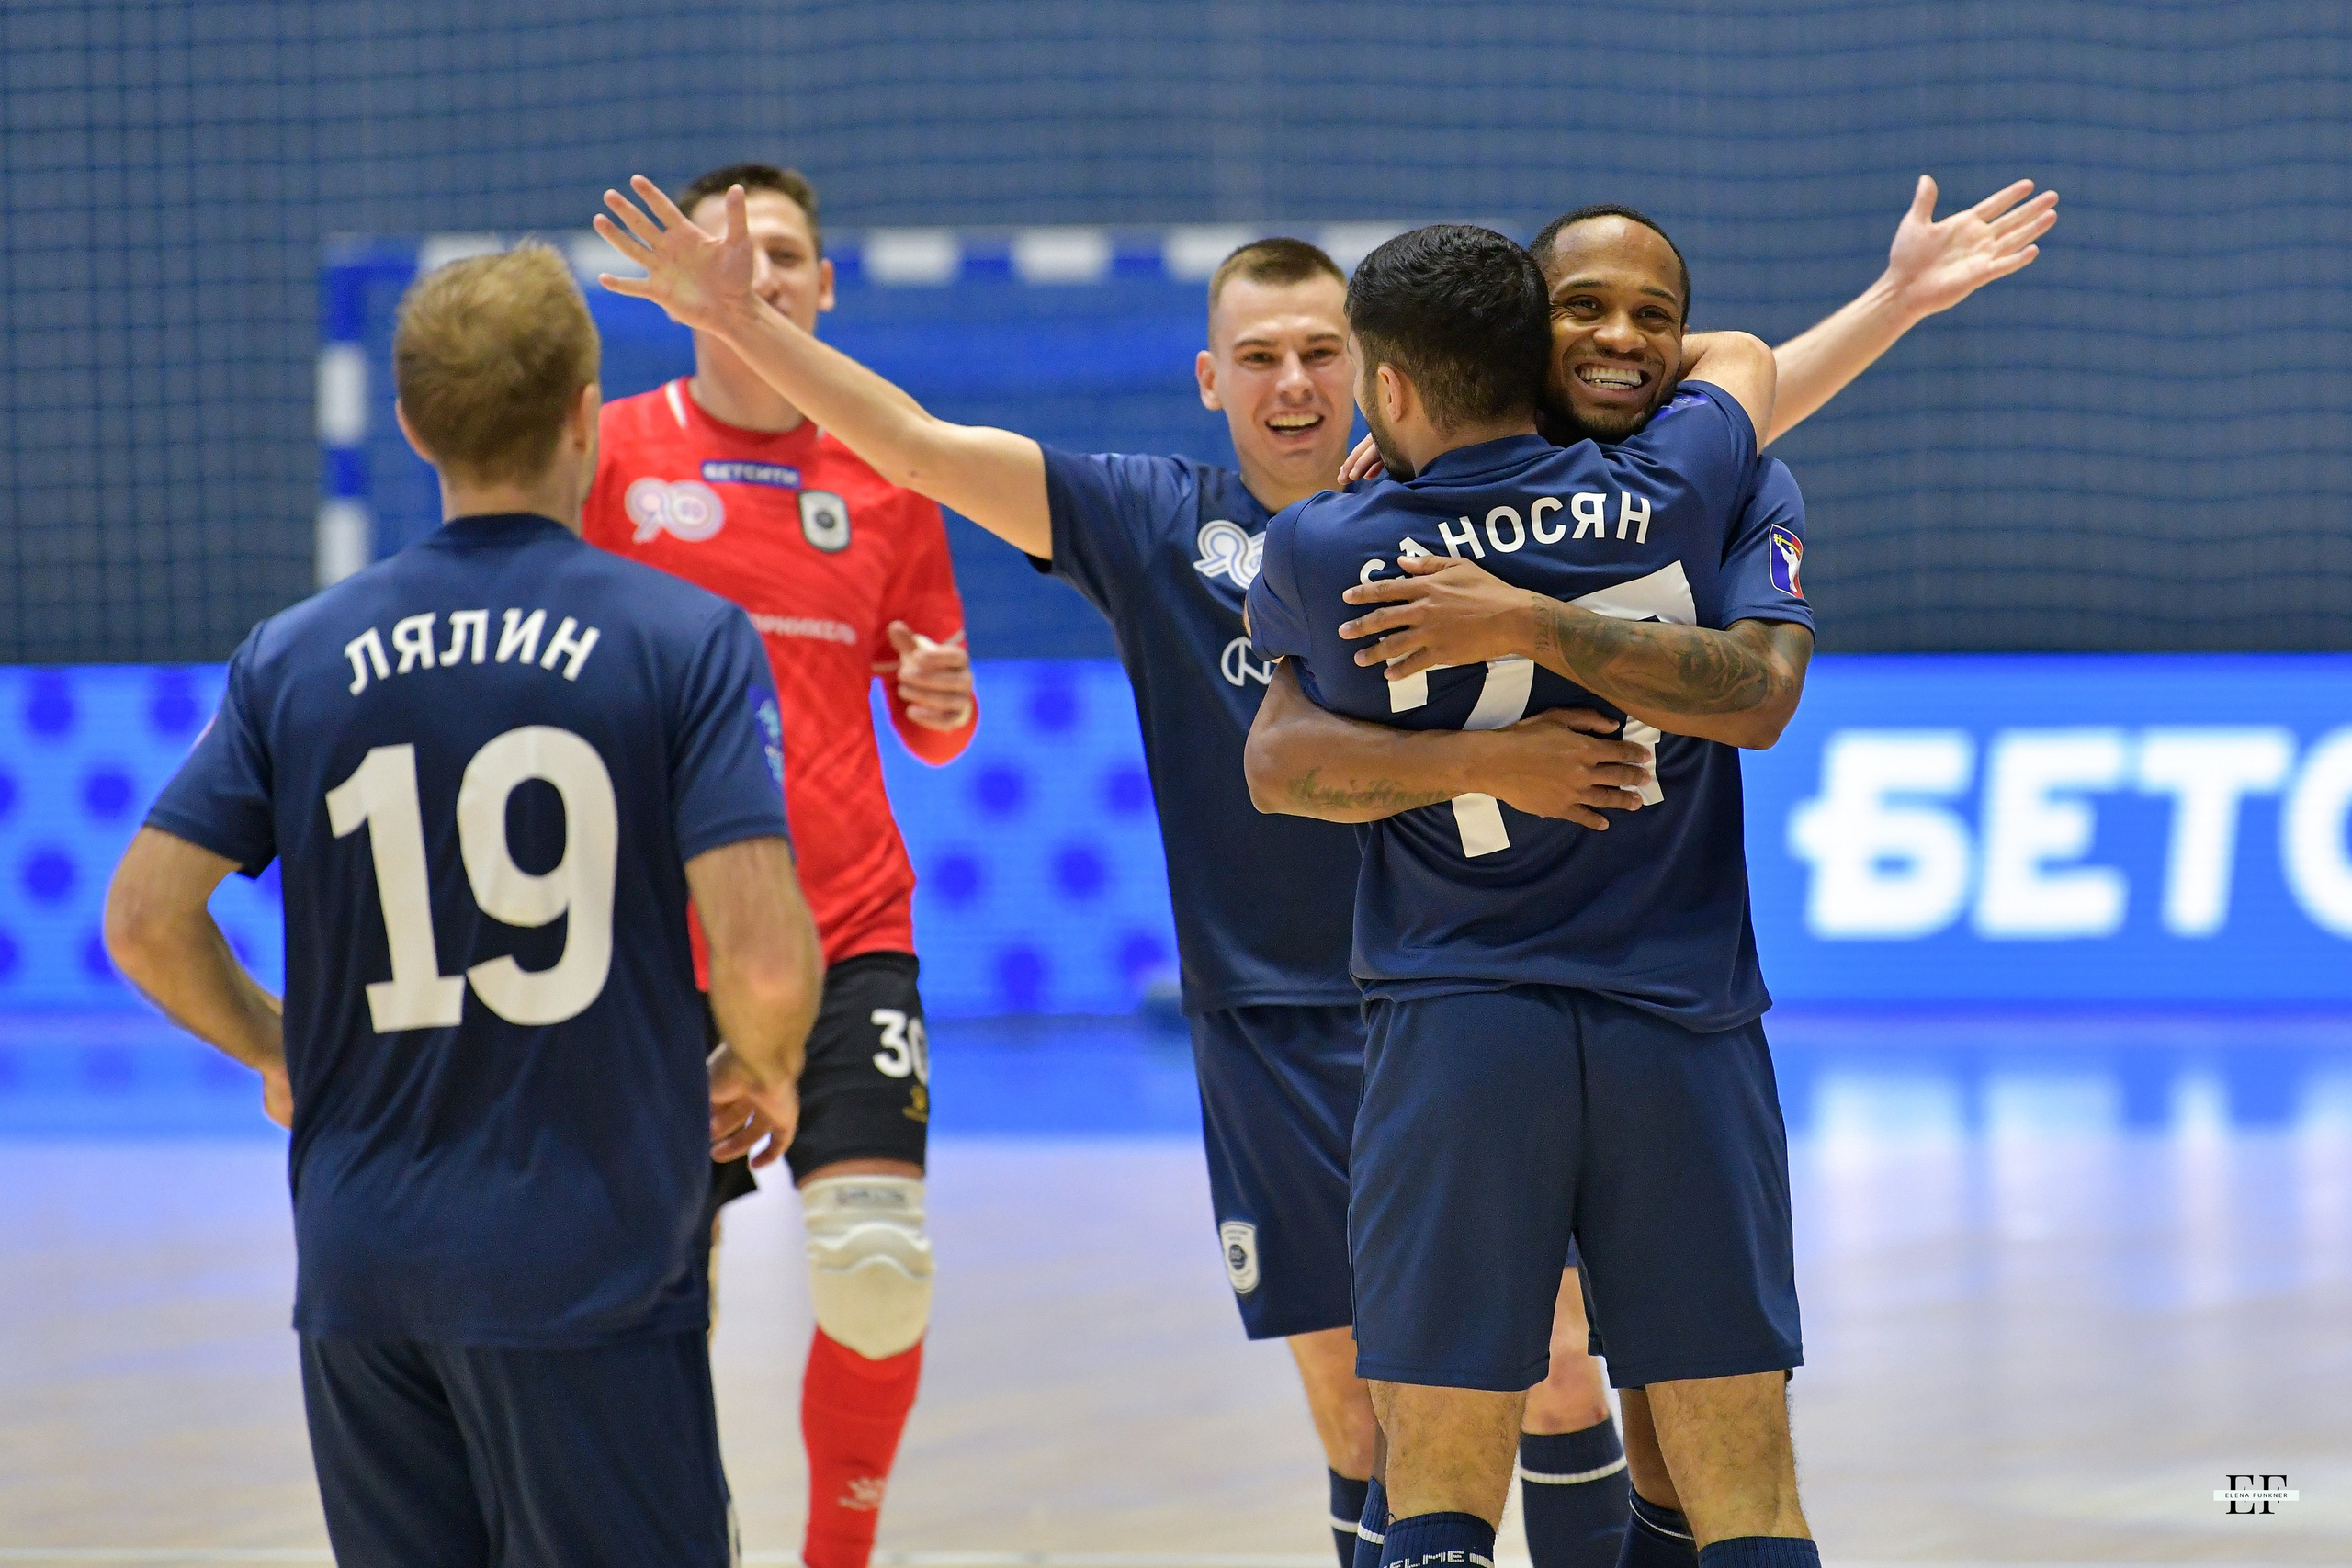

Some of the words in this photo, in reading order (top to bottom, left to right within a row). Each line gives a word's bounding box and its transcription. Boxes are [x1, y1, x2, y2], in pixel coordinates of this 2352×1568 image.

[345, 607, 600, 696] ЛЯЛИН
[325, 724, 619, 1033] 19
[1383, 1550, 1464, 1568] ELME
